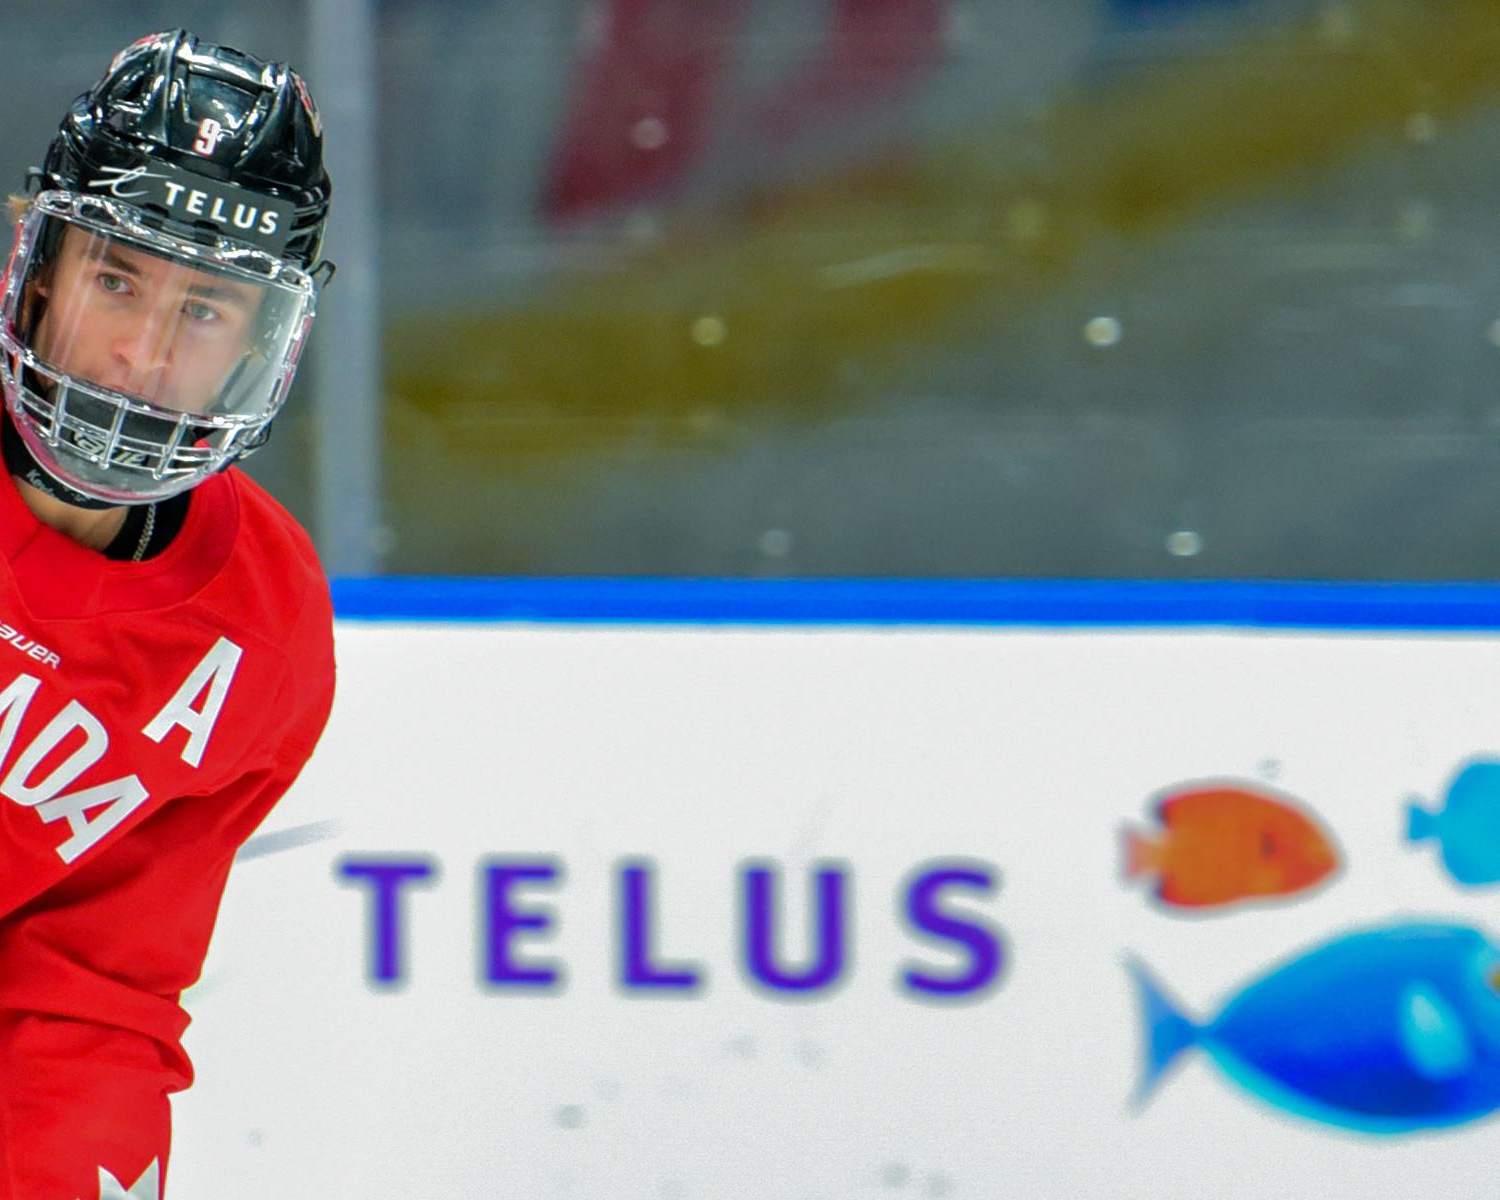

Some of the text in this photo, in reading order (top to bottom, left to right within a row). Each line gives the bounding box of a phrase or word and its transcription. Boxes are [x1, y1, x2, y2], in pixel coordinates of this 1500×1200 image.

[192, 117, 221, 157] 9
[164, 181, 279, 235] TELUS
[142, 636, 244, 768] A
[334, 857, 1012, 1000] TELUS
